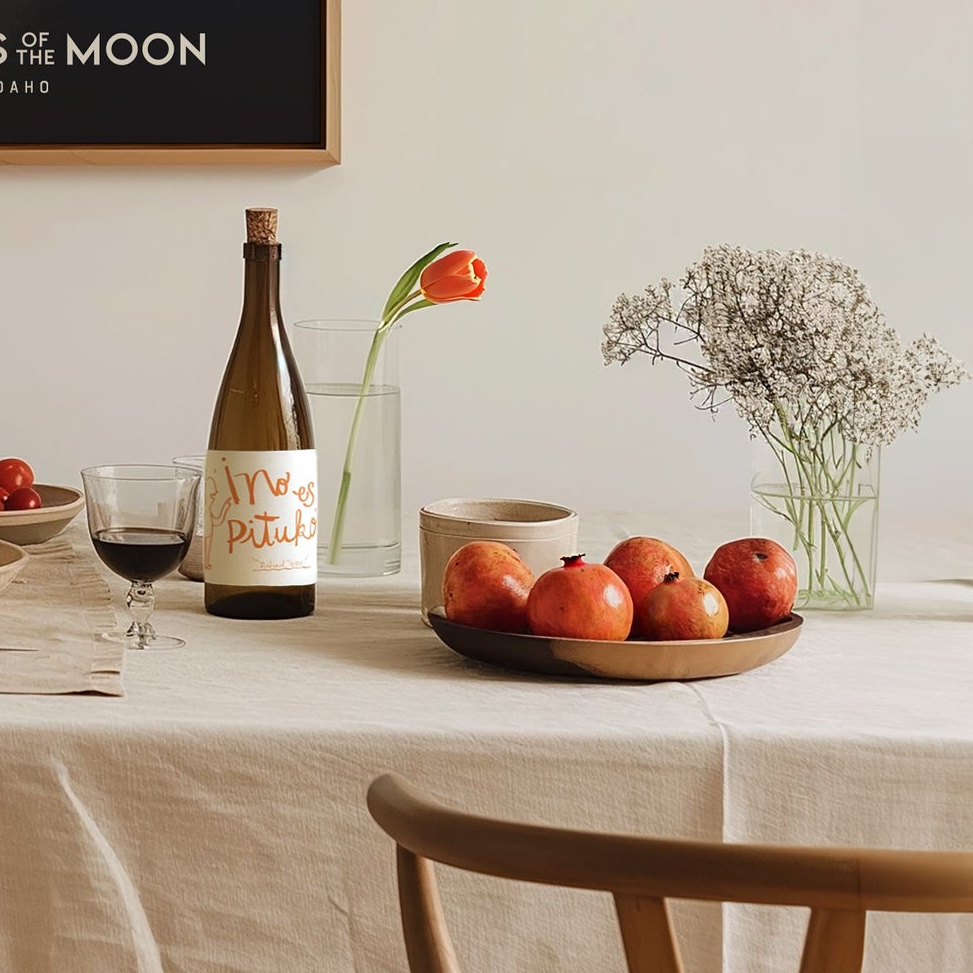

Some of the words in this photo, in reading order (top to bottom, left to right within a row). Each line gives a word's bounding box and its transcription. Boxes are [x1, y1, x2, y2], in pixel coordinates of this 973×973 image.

[21, 31, 50, 48] OF
[66, 32, 206, 66] MOON
[15, 49, 55, 66] THE
[292, 481, 315, 508] es
